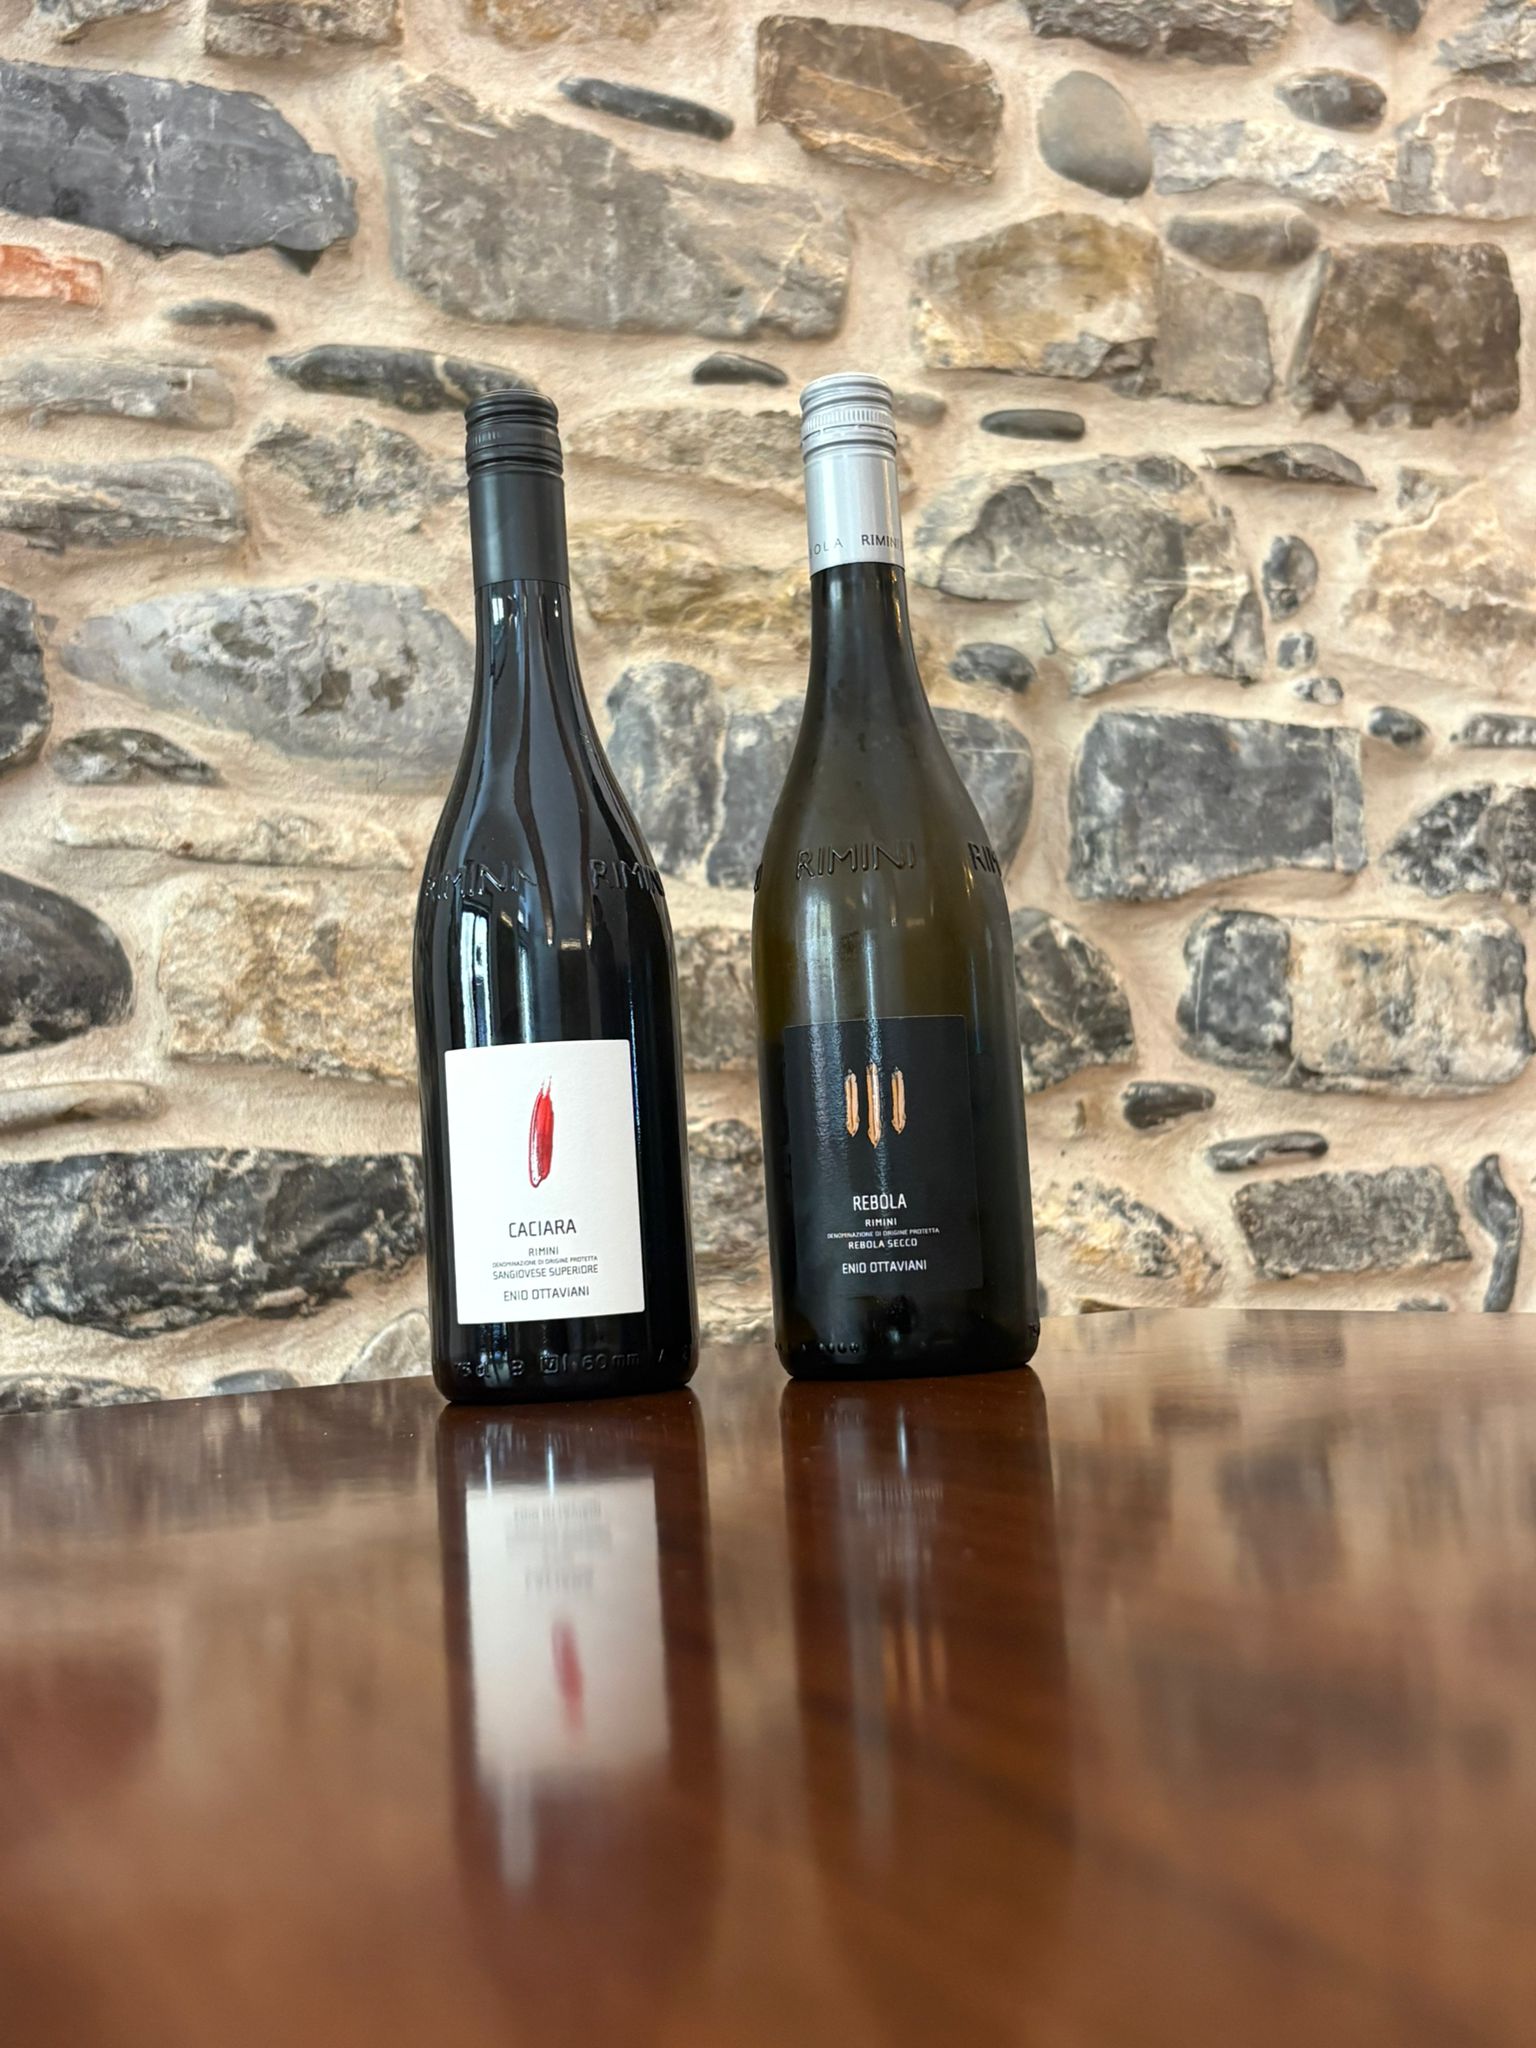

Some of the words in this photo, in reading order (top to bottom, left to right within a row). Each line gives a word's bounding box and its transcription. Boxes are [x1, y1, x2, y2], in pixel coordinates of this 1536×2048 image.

[796, 841, 917, 880] RIMINI
[853, 1193, 907, 1212] REBOLA
[508, 1219, 577, 1238] CACIARA
[865, 1217, 897, 1227] RIMINI
[827, 1231, 873, 1239] DENOMINAZIONE
[909, 1227, 940, 1235] PROTETTA
[528, 1246, 559, 1257] RIMINI
[848, 1240, 885, 1250] REBOLA
[887, 1238, 918, 1248] SECCO
[492, 1260, 536, 1268] DENOMINAZIONE
[569, 1255, 598, 1263] PROTETTA
[842, 1261, 867, 1275] ENIO
[870, 1259, 927, 1274] OTTAVIANI
[492, 1268, 547, 1280] SANGIOVESE
[549, 1264, 599, 1277] SUPERIORE
[503, 1289, 528, 1302] ENIO
[531, 1285, 590, 1301] OTTAVIANI
